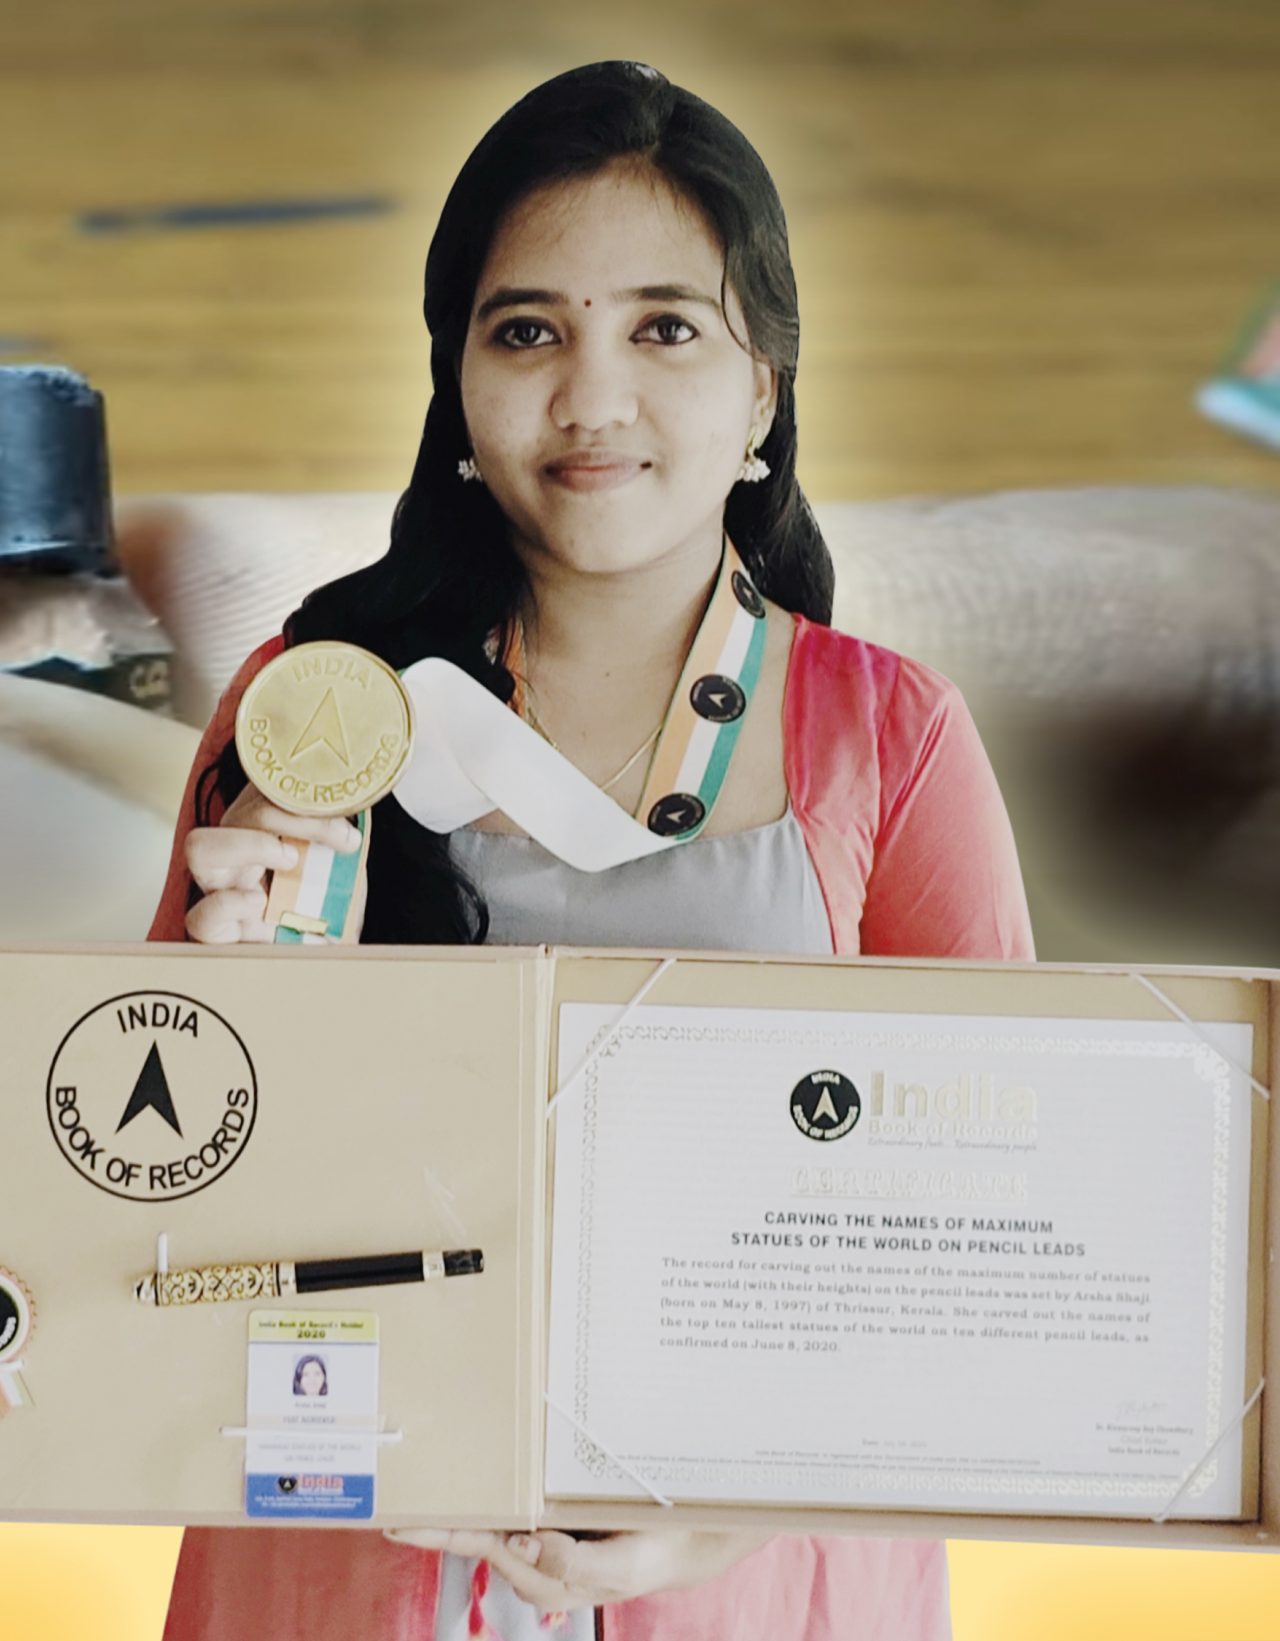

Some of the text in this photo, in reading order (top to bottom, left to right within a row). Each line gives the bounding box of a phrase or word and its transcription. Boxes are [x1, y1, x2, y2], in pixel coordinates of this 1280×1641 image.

[292, 656, 368, 689] INDIA
[250, 718, 399, 803] BOOK OF RECORDS
[117, 1002, 198, 1038] INDIA
[872, 1071, 1038, 1122] India
[55, 1086, 249, 1190] BOOK OF RECORDS
[869, 1120, 918, 1136] Book
[765, 1212, 1053, 1233] CARVING THE NAMES OF MAXIMUM
[731, 1232, 1086, 1257] STATUES OF THE WORLD ON PENCIL LEADS
[662, 1257, 1151, 1284] The record for carving out the names of the maximum number of statues
[661, 1277, 675, 1288] of
[678, 1277, 700, 1289] the
[703, 1278, 740, 1290] world
[743, 1279, 778, 1292] (with
[781, 1280, 813, 1292] their
[817, 1281, 871, 1295] heights)
[874, 1285, 892, 1295] on
[895, 1283, 917, 1296] the
[921, 1285, 962, 1299] pencil
[965, 1286, 1000, 1299] leads
[1003, 1290, 1028, 1300] was
[1031, 1289, 1051, 1300] set
[1055, 1290, 1070, 1303] by
[1073, 1290, 1113, 1302] Arsha
[660, 1297, 695, 1309] (born
[700, 1299, 717, 1309] on
[722, 1299, 750, 1312] May
[754, 1300, 768, 1312] 8,
[773, 1300, 811, 1314] 1997)
[816, 1301, 831, 1312] of
[900, 1304, 947, 1317] Kerala.
[953, 1306, 978, 1318] She
[983, 1307, 1028, 1320] carved
[1033, 1309, 1056, 1320] out
[1061, 1309, 1083, 1321] the
[1087, 1312, 1132, 1323] names
[1137, 1312, 1151, 1323] of
[297, 1329, 326, 1339] 2020
[660, 1316, 1149, 1344] the top ten tallest statues of the world on ten different pencil leads, as
[660, 1336, 729, 1349] confirmed
[731, 1339, 748, 1349] on
[751, 1338, 785, 1350] June
[803, 1341, 842, 1353] 2020.
